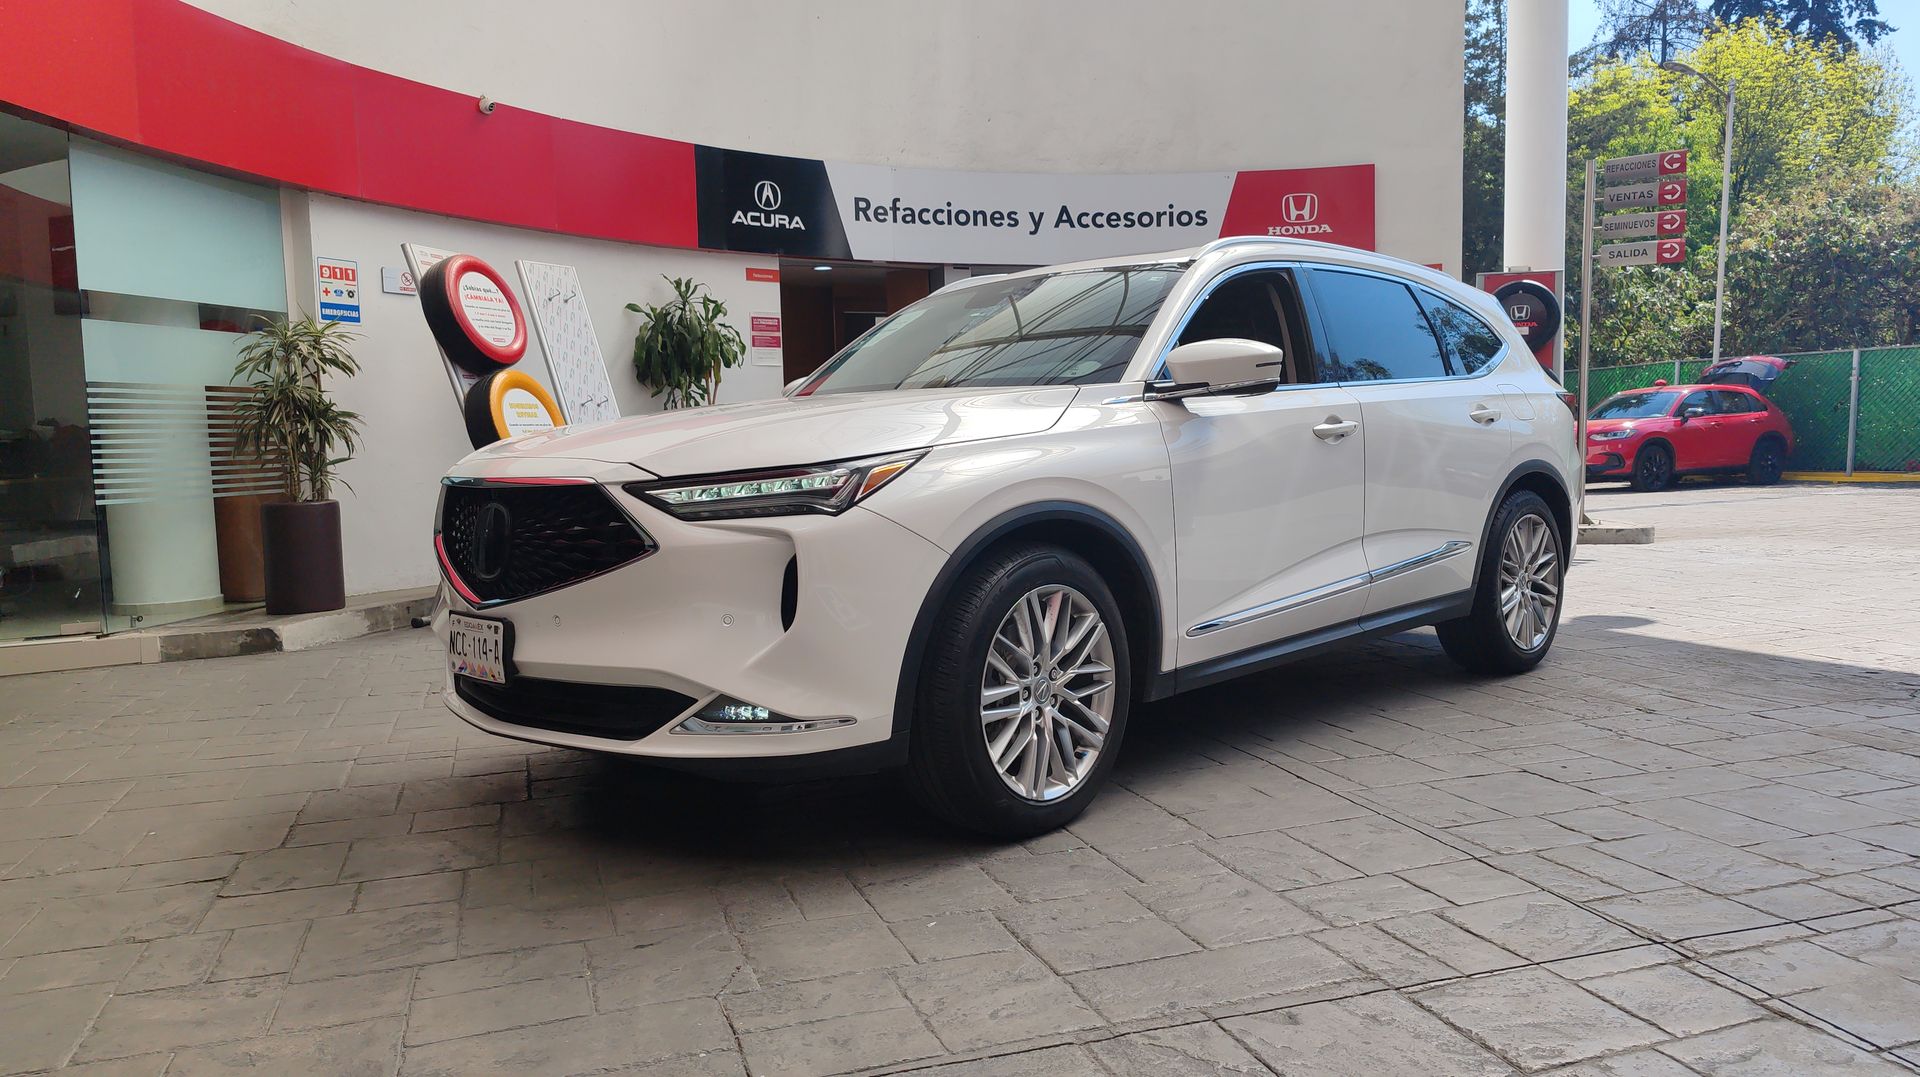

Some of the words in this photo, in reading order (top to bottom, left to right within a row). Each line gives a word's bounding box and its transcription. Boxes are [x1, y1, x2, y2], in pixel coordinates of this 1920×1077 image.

[1606, 159, 1657, 174] REFACCIONES
[1608, 189, 1654, 203] VENTAS
[731, 210, 806, 231] ACURA
[854, 196, 1020, 228] Refacciones
[1029, 210, 1045, 235] y
[1054, 204, 1208, 229] Accesorios
[1268, 223, 1333, 236] HONDA
[1604, 219, 1655, 231] SEMINUEVOS
[1608, 248, 1649, 260] SALIDA
[321, 266, 354, 280] 911
[321, 307, 360, 318] EMERGENCIAS
